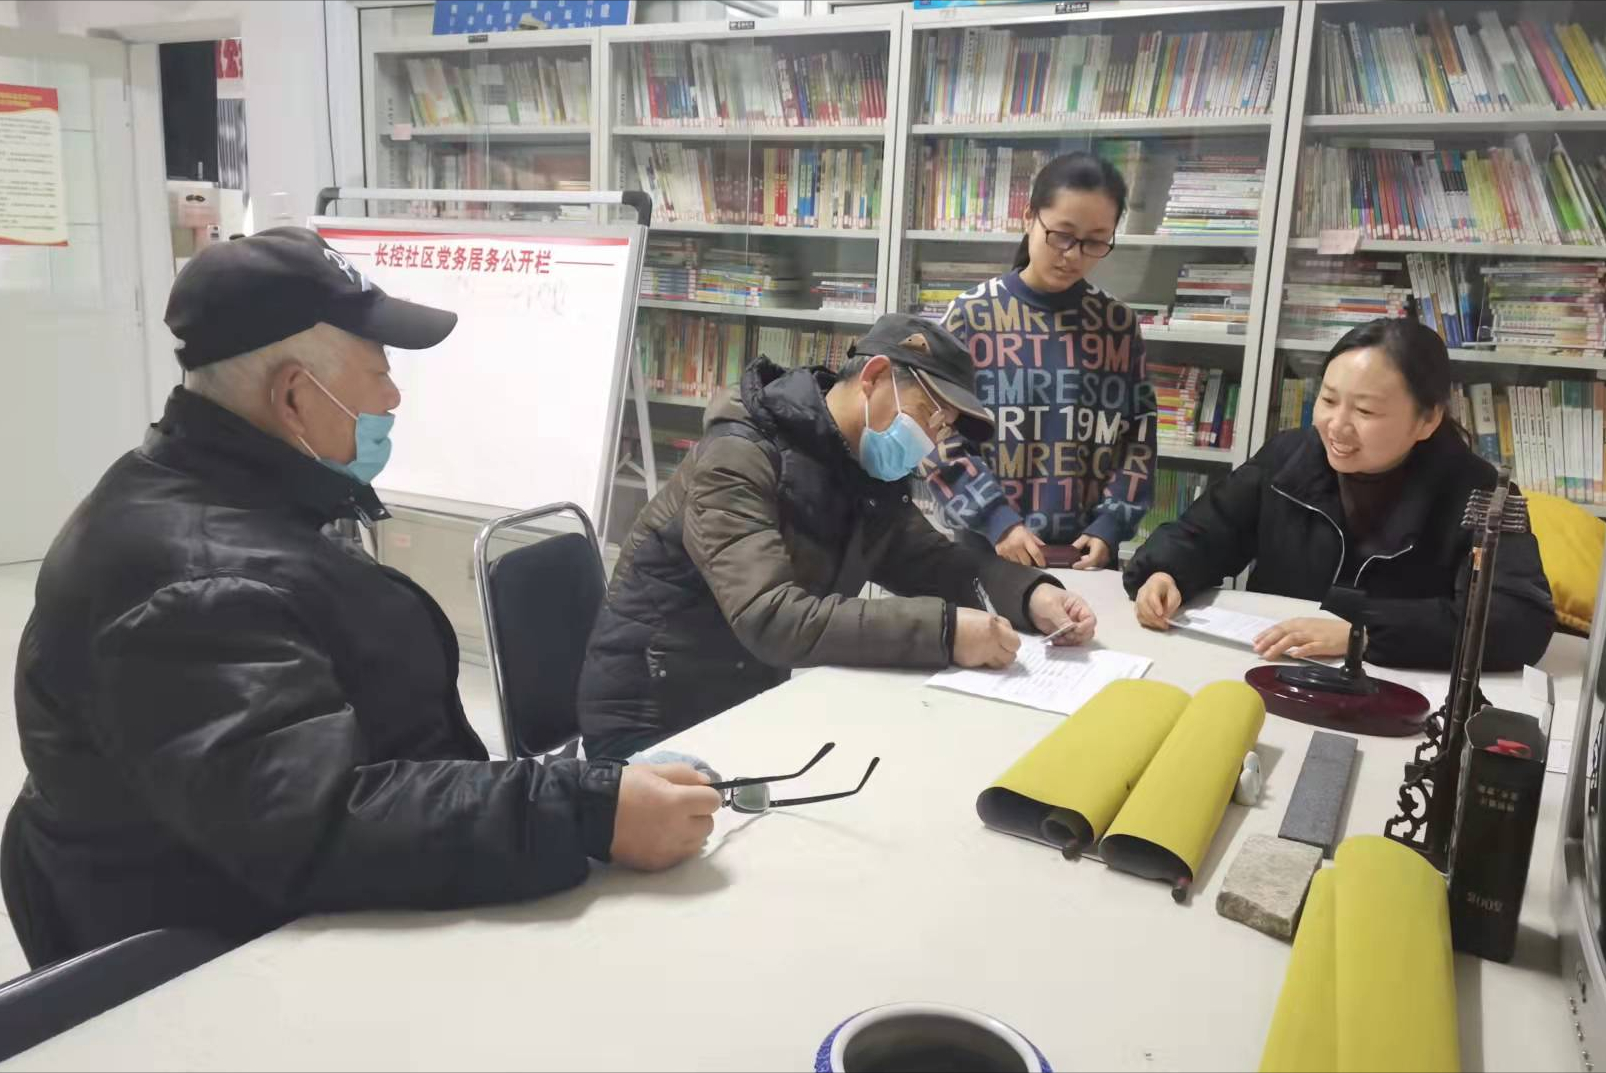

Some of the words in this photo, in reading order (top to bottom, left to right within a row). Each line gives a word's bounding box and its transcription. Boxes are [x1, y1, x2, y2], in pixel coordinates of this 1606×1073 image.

[374, 242, 552, 274] 长控社区党务居务公开栏
